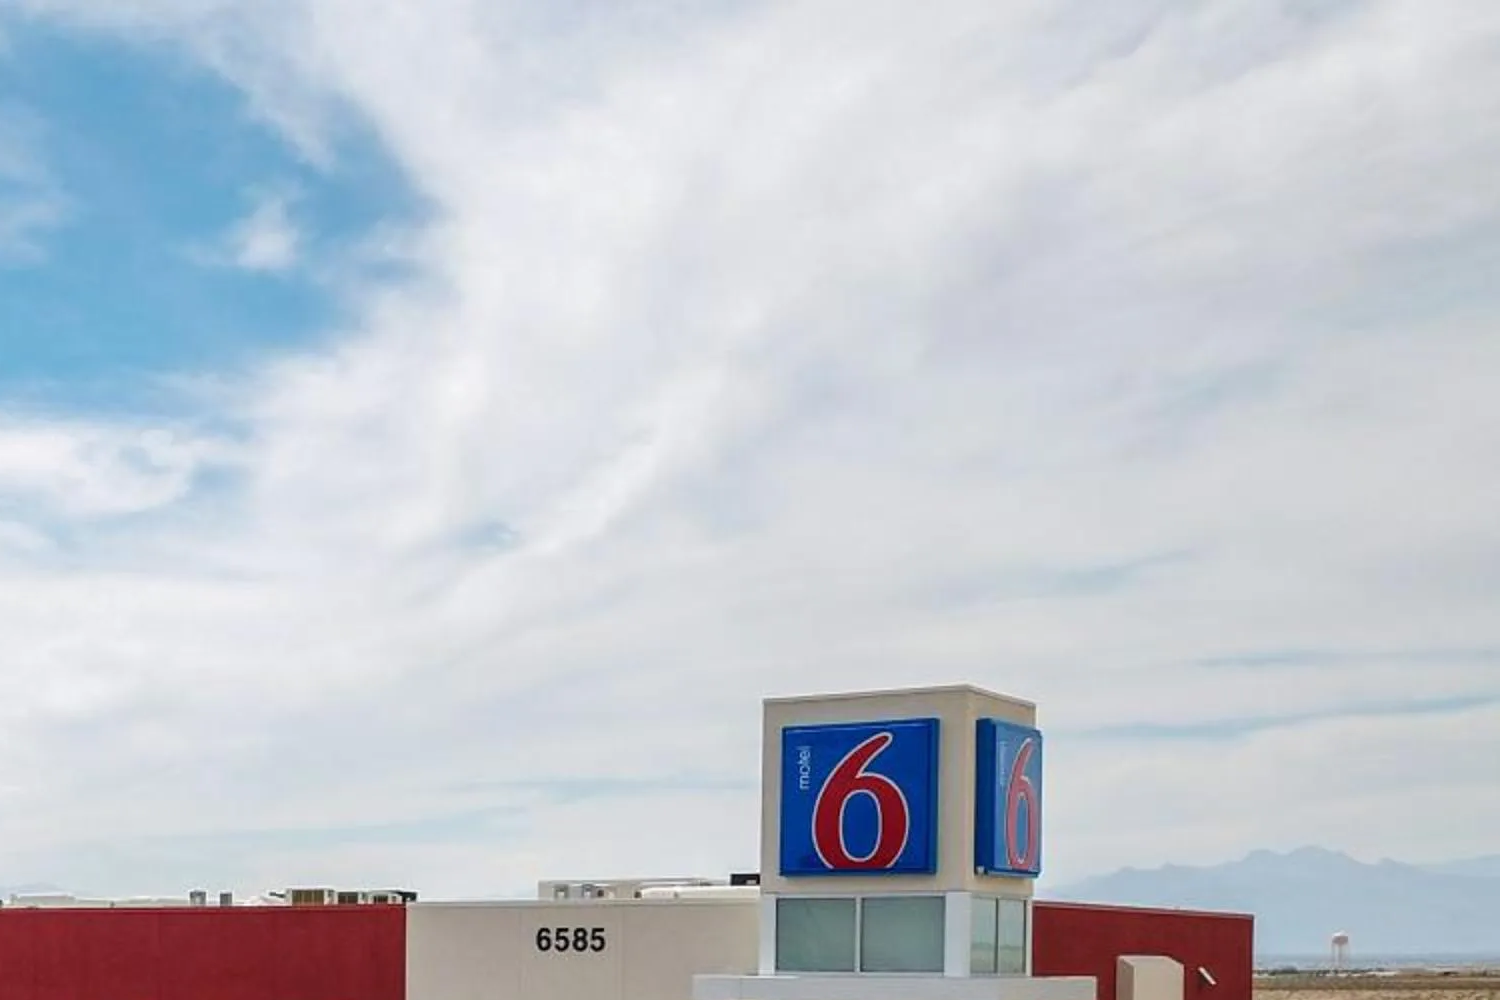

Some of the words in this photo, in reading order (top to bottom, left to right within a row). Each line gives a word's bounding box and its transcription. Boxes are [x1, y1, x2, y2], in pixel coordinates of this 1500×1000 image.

[798, 745, 811, 790] motel
[813, 732, 909, 868] 6
[1006, 738, 1040, 869] 6
[536, 927, 606, 952] 6585
